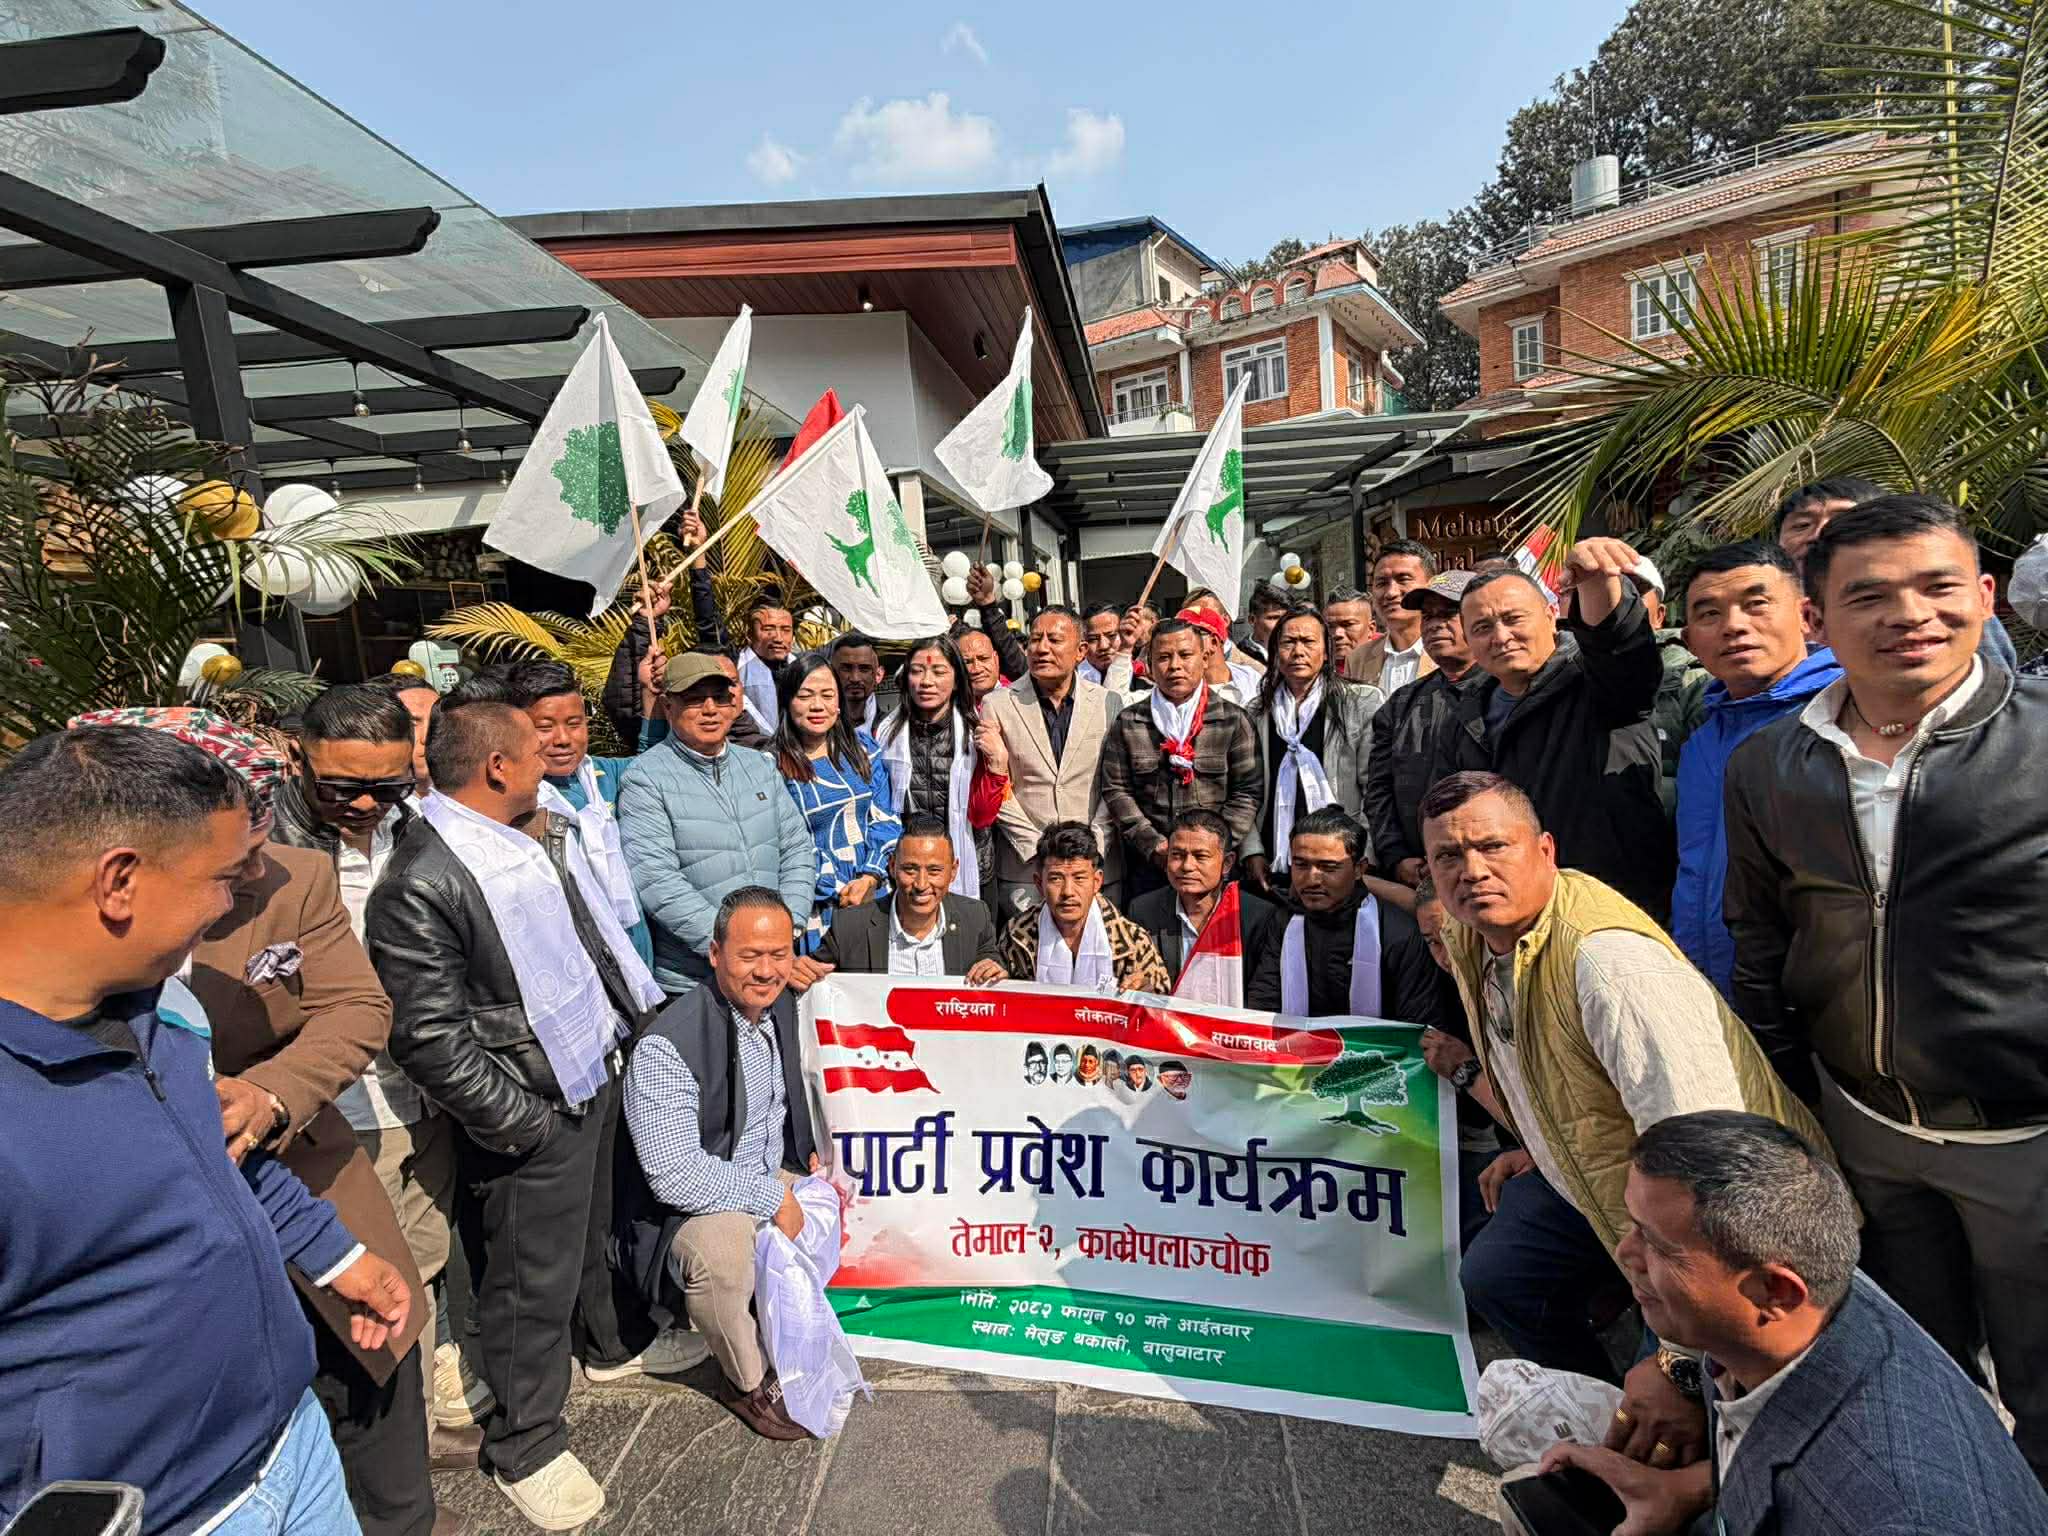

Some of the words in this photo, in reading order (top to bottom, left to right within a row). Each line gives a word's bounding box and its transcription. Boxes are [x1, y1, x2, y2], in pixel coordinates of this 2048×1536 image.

[934, 997, 996, 1019] राष्ट्रियता
[1074, 1005, 1129, 1030] लोकतन्त्र
[832, 1111, 955, 1197] पार्टी
[972, 1115, 1109, 1199] प्रवेश
[1136, 1138, 1406, 1237] कार्यक्रम
[949, 1217, 1061, 1260] तेमाल-२,
[1009, 1300, 1052, 1318] २०८२
[1061, 1305, 1108, 1325] फागुन
[1115, 1312, 1136, 1326] १०
[1144, 1313, 1170, 1330] गते
[1177, 1317, 1254, 1342] आईतवार
[1143, 1341, 1226, 1366] बालुवाटार
